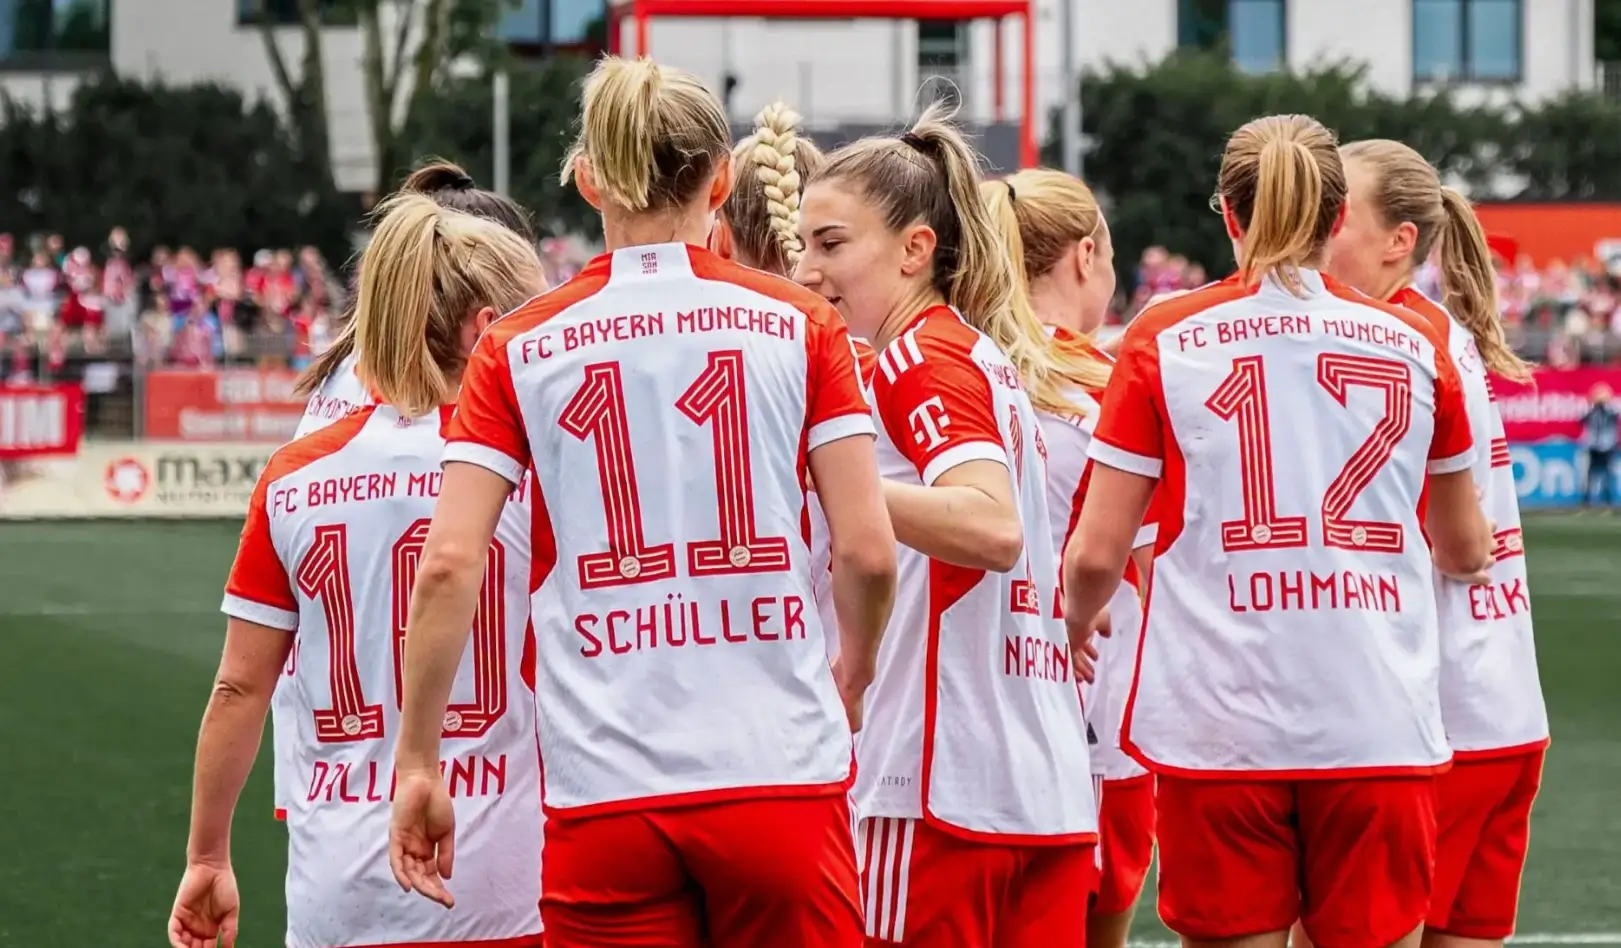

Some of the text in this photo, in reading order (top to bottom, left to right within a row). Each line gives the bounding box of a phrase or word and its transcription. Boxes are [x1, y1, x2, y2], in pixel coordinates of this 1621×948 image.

[522, 307, 795, 364] FC BAYERN MÜNCHEN
[1178, 314, 1421, 356] FC BAYERN MÜNCHEN
[557, 350, 791, 590] 11
[1204, 352, 1411, 554] 12
[272, 488, 297, 517] FC
[307, 472, 397, 507] BAYERN
[1228, 570, 1401, 612] LOHMANN
[574, 593, 806, 658] SCHÜLLER
